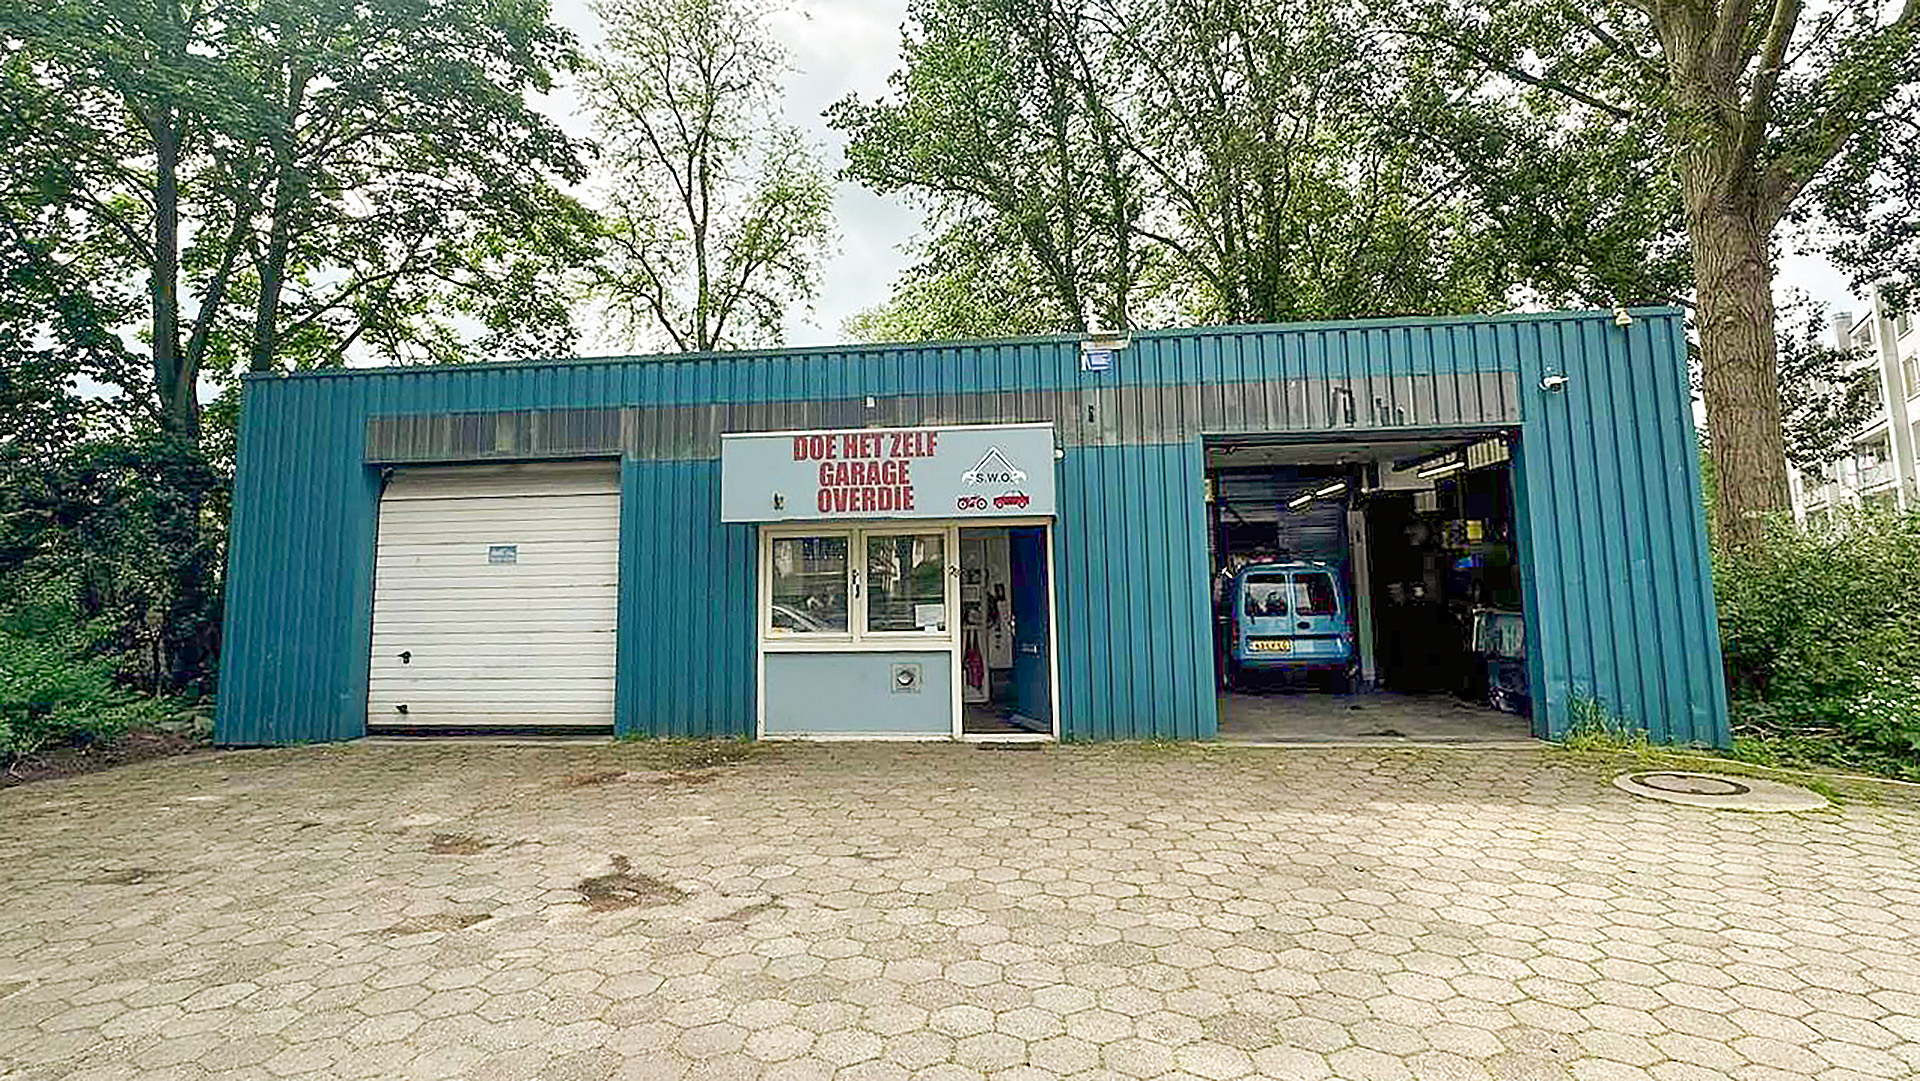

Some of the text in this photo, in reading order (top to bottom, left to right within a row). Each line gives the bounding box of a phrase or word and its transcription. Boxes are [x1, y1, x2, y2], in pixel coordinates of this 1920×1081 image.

[793, 430, 938, 461] DOE HET ZELF
[819, 460, 910, 487] GARAGE
[817, 485, 914, 513] OVERDIE
